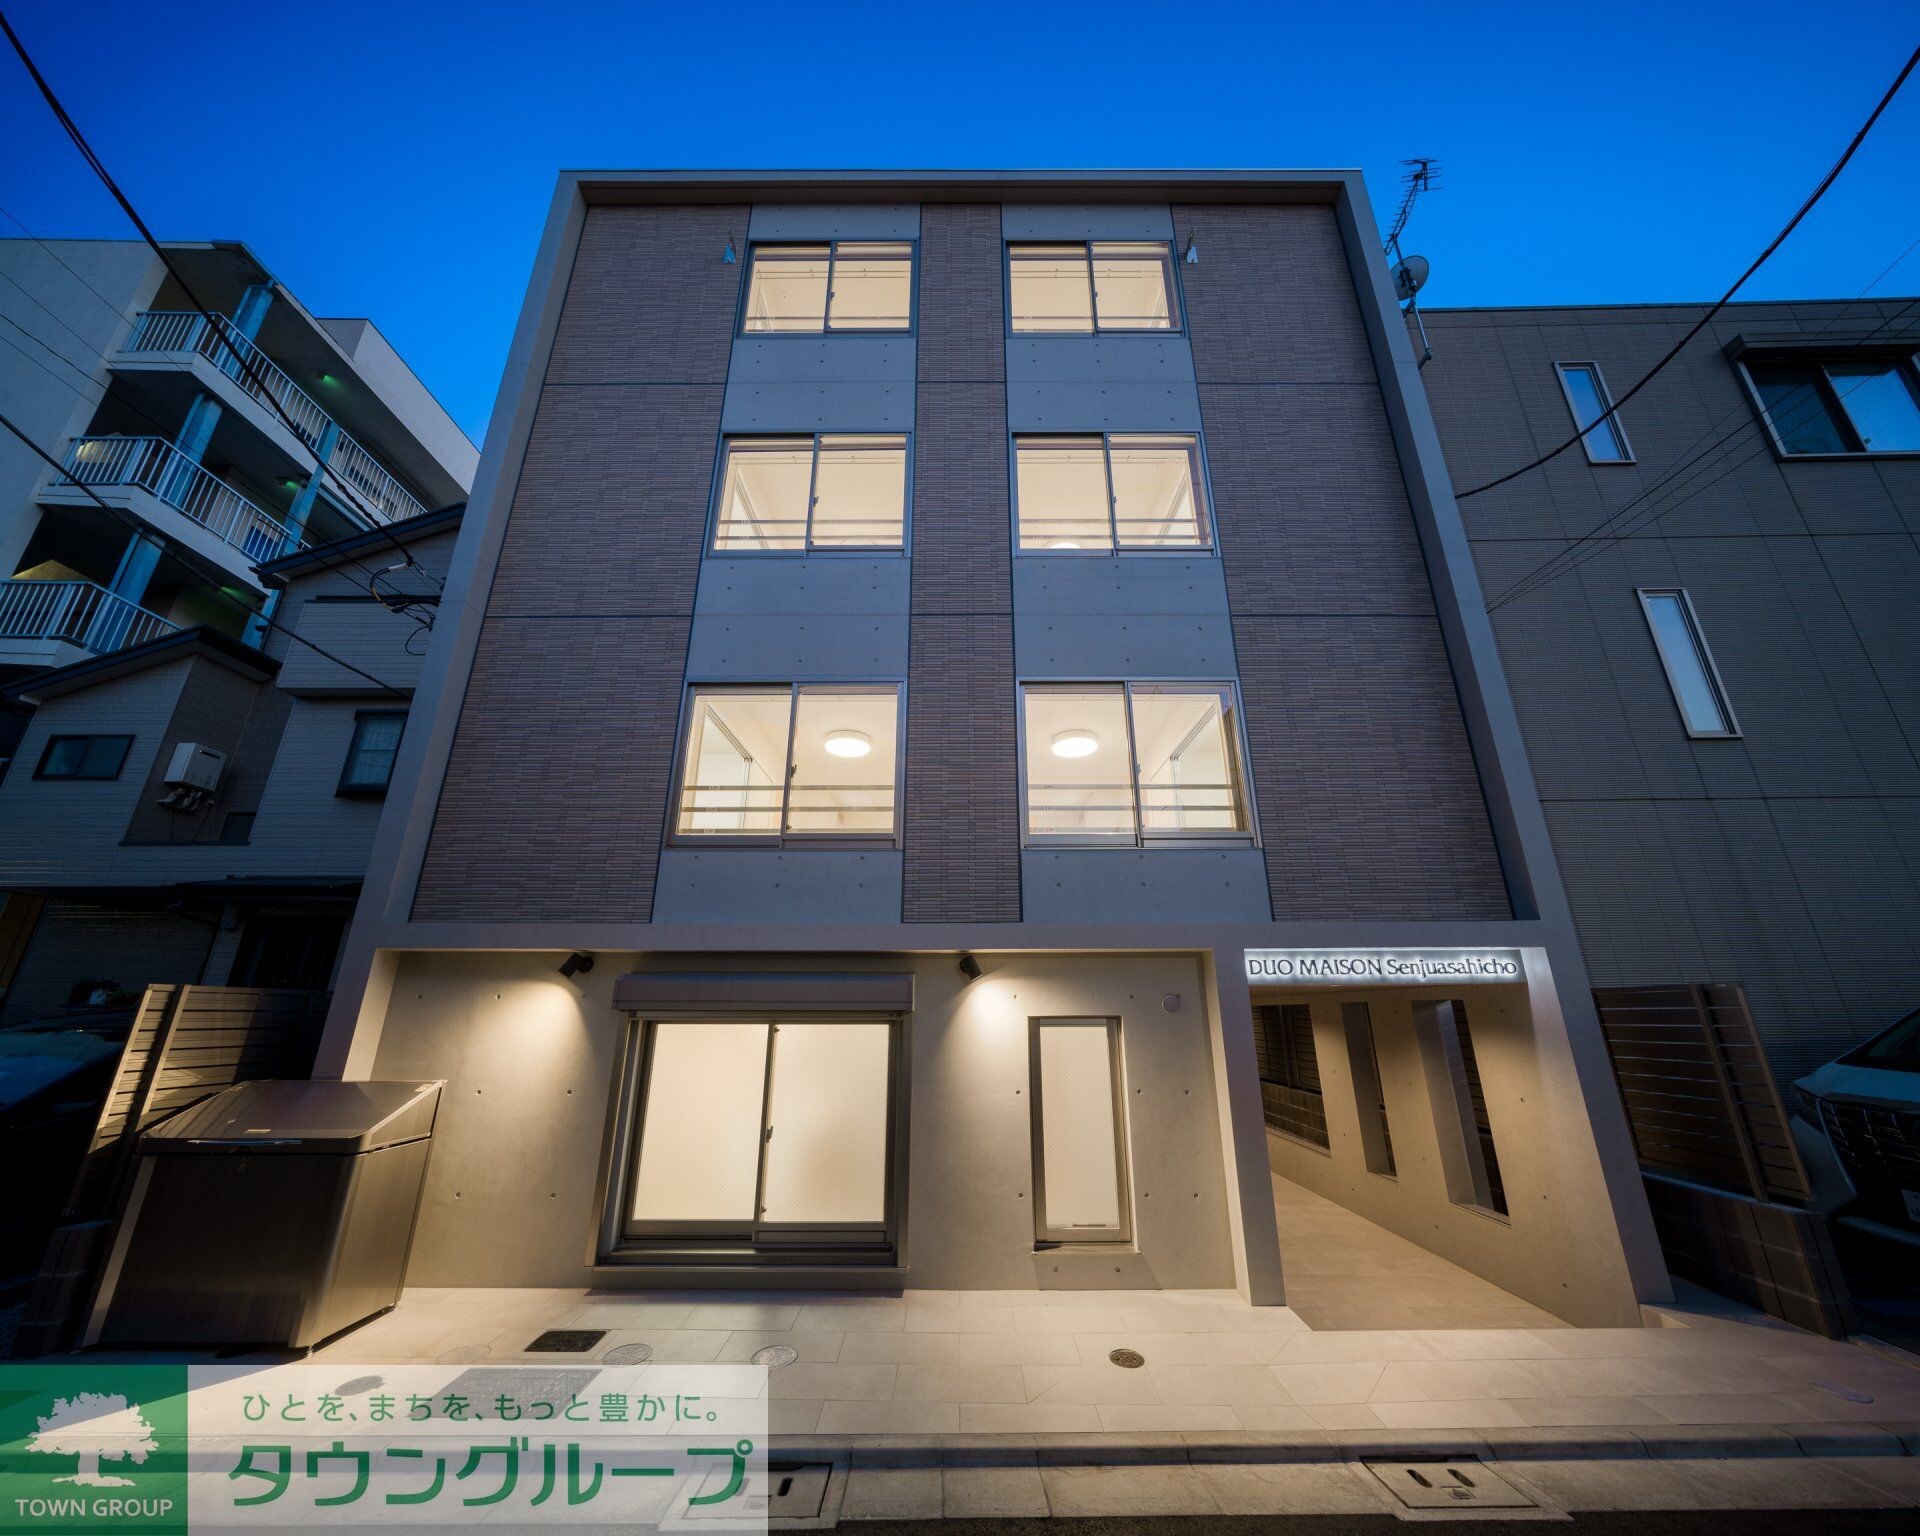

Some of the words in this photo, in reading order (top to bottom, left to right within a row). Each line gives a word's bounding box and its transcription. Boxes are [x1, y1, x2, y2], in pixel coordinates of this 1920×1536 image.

[1248, 958, 1294, 976] DUO
[1299, 958, 1383, 976] MAISON
[1386, 958, 1517, 979] Senjuasahicho
